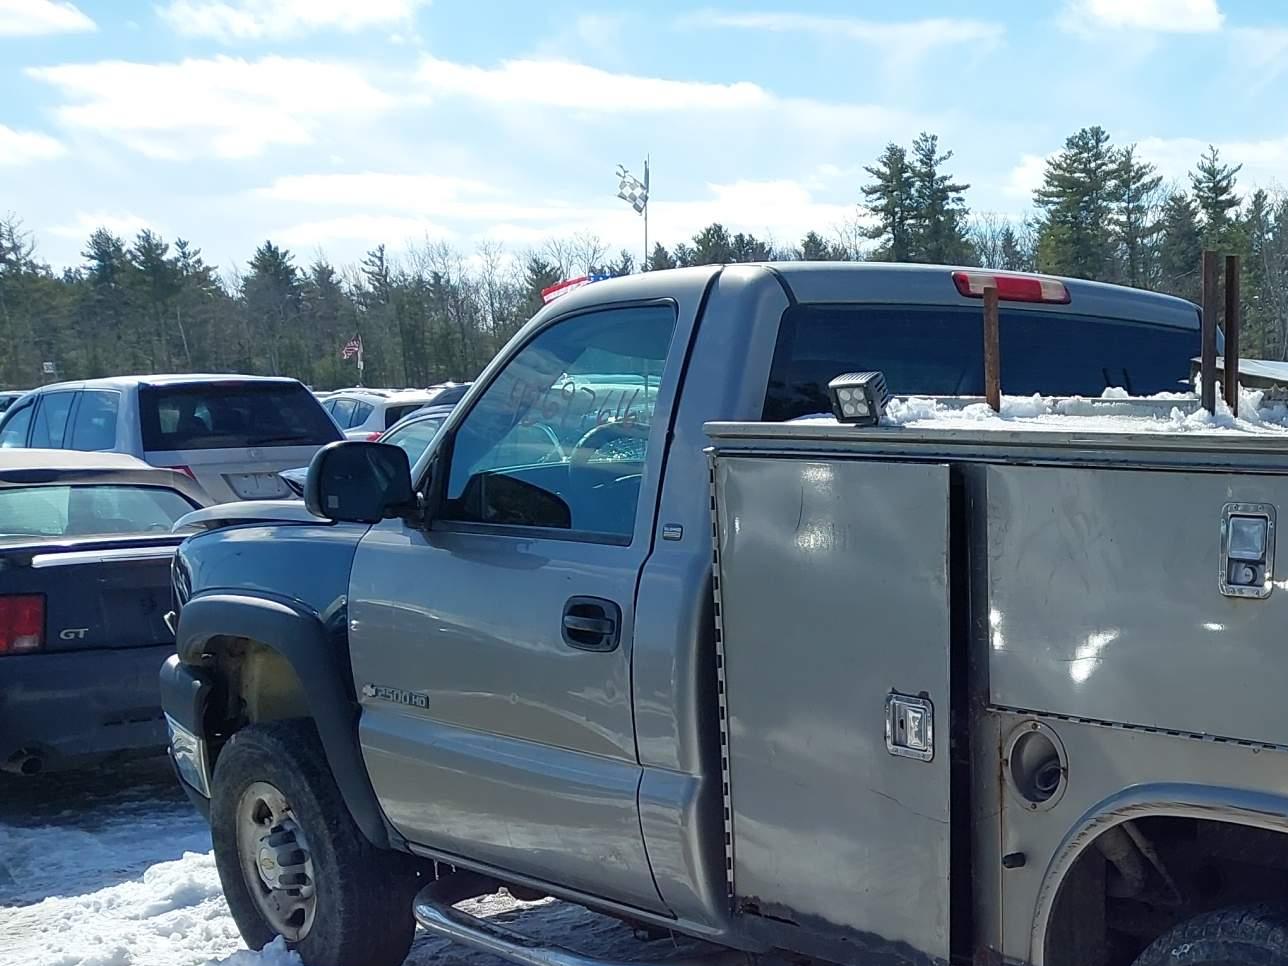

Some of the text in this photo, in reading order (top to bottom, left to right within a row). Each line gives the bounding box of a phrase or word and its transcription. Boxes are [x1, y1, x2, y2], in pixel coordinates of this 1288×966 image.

[59, 628, 89, 640] GT
[377, 686, 427, 708] 2500 HD
